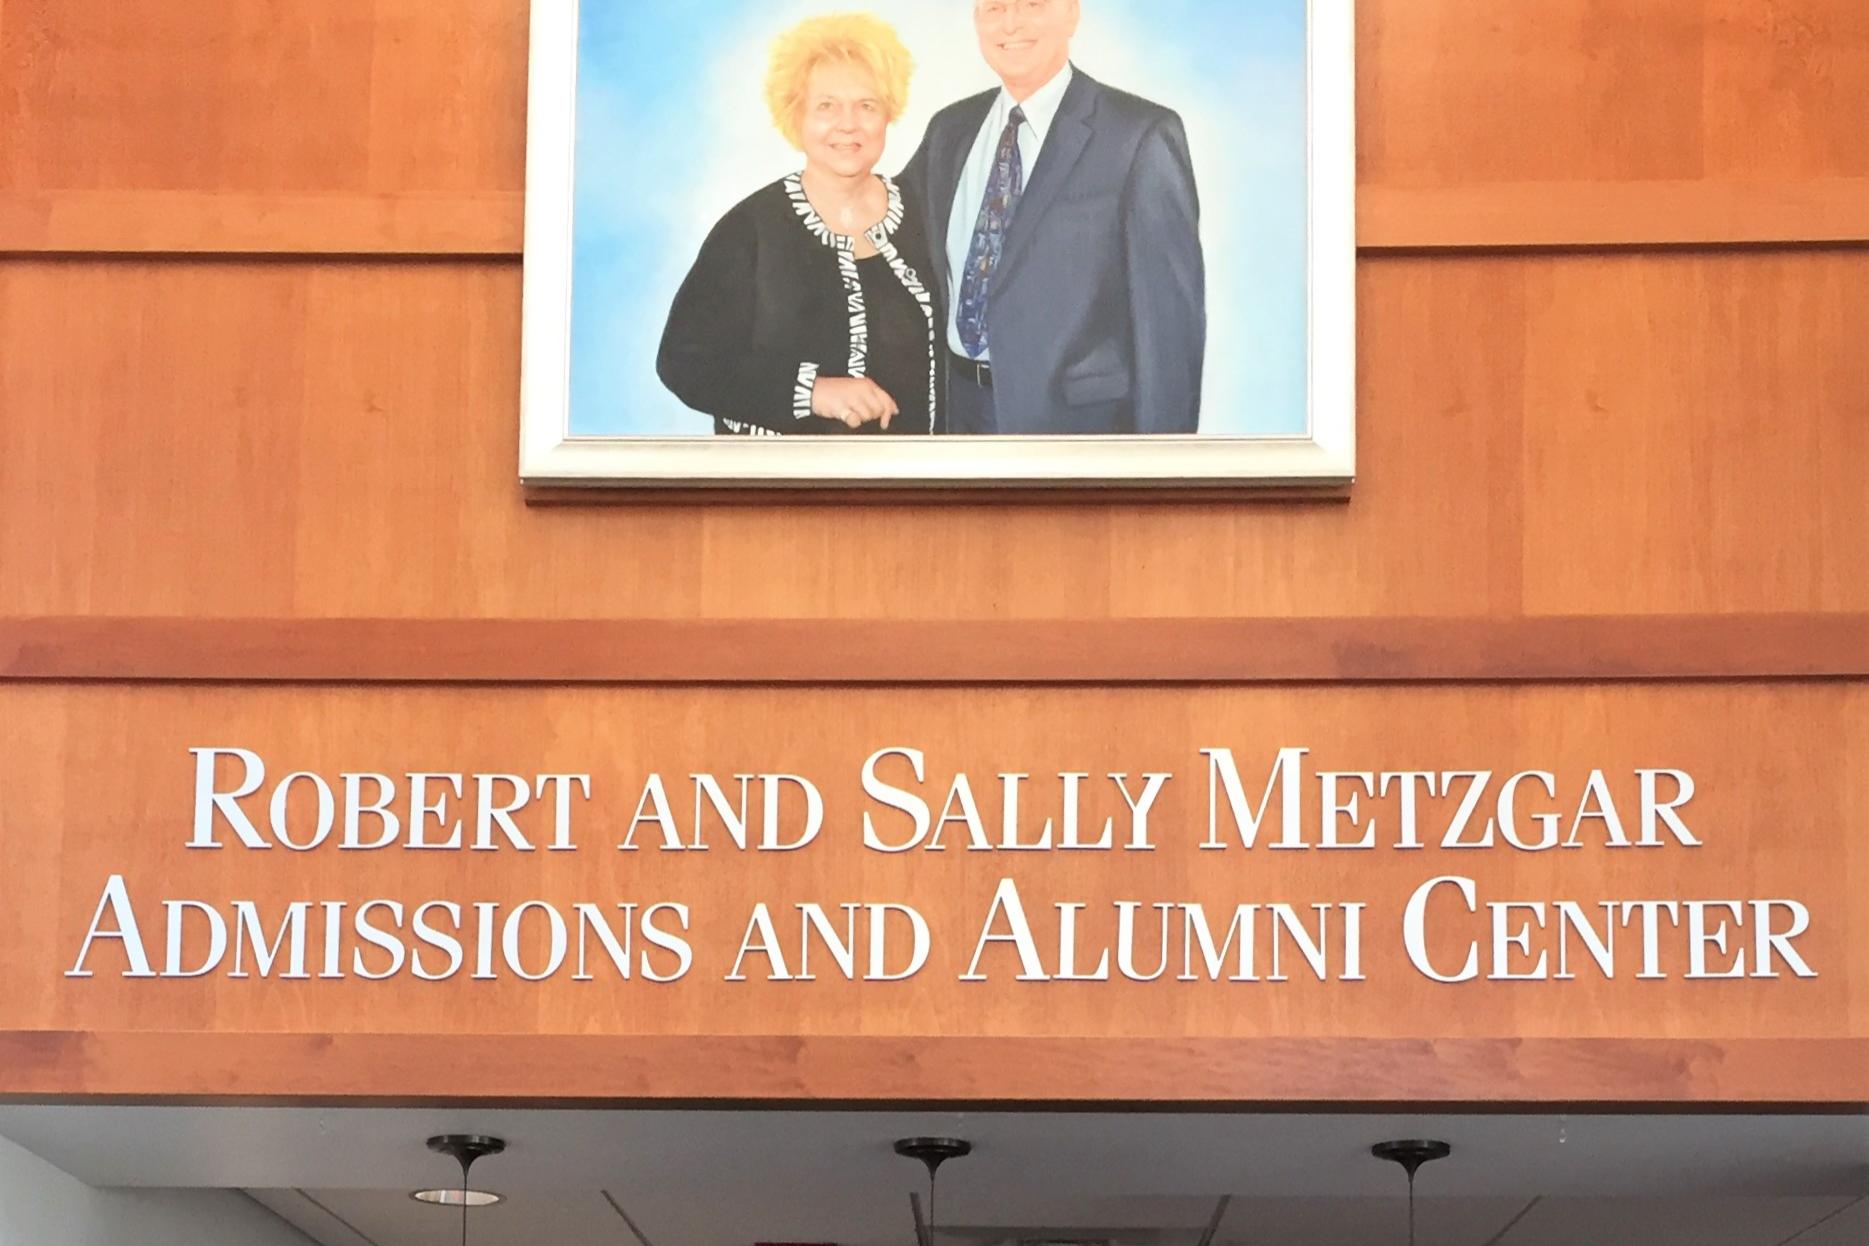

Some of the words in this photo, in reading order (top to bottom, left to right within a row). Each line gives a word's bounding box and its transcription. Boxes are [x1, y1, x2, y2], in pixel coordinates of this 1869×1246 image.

[185, 747, 591, 850] ROBERT
[618, 773, 824, 850] AND
[861, 746, 1173, 852] SALLY
[1200, 747, 1703, 851] METZGAR
[64, 874, 693, 982] ADMISSIONS
[724, 902, 931, 980] AND
[959, 877, 1367, 981] ALUMNI
[1403, 875, 1819, 982] CENTER
